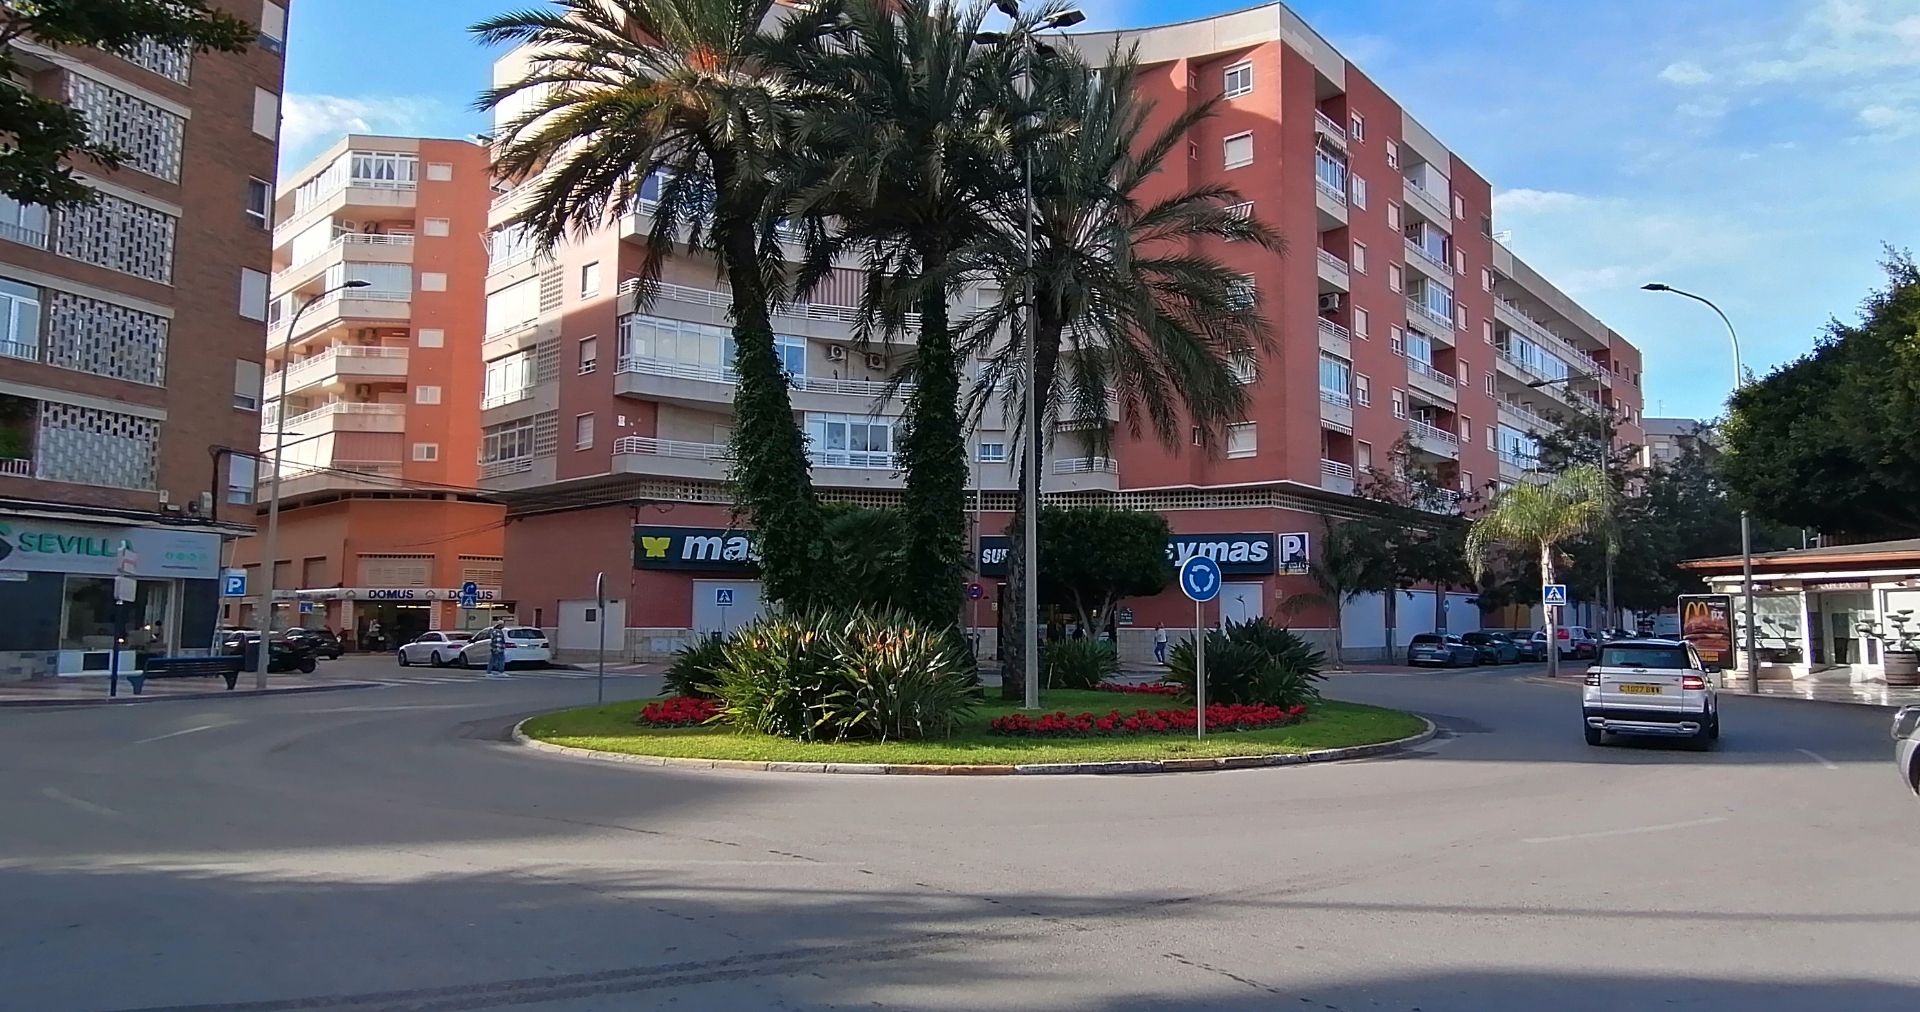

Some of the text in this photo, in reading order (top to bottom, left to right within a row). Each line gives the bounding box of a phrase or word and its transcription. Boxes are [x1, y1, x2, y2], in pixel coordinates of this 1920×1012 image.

[1282, 535, 1302, 562] P
[227, 578, 242, 593] P
[368, 589, 414, 599] DOMUS
[448, 590, 494, 600] DOUS
